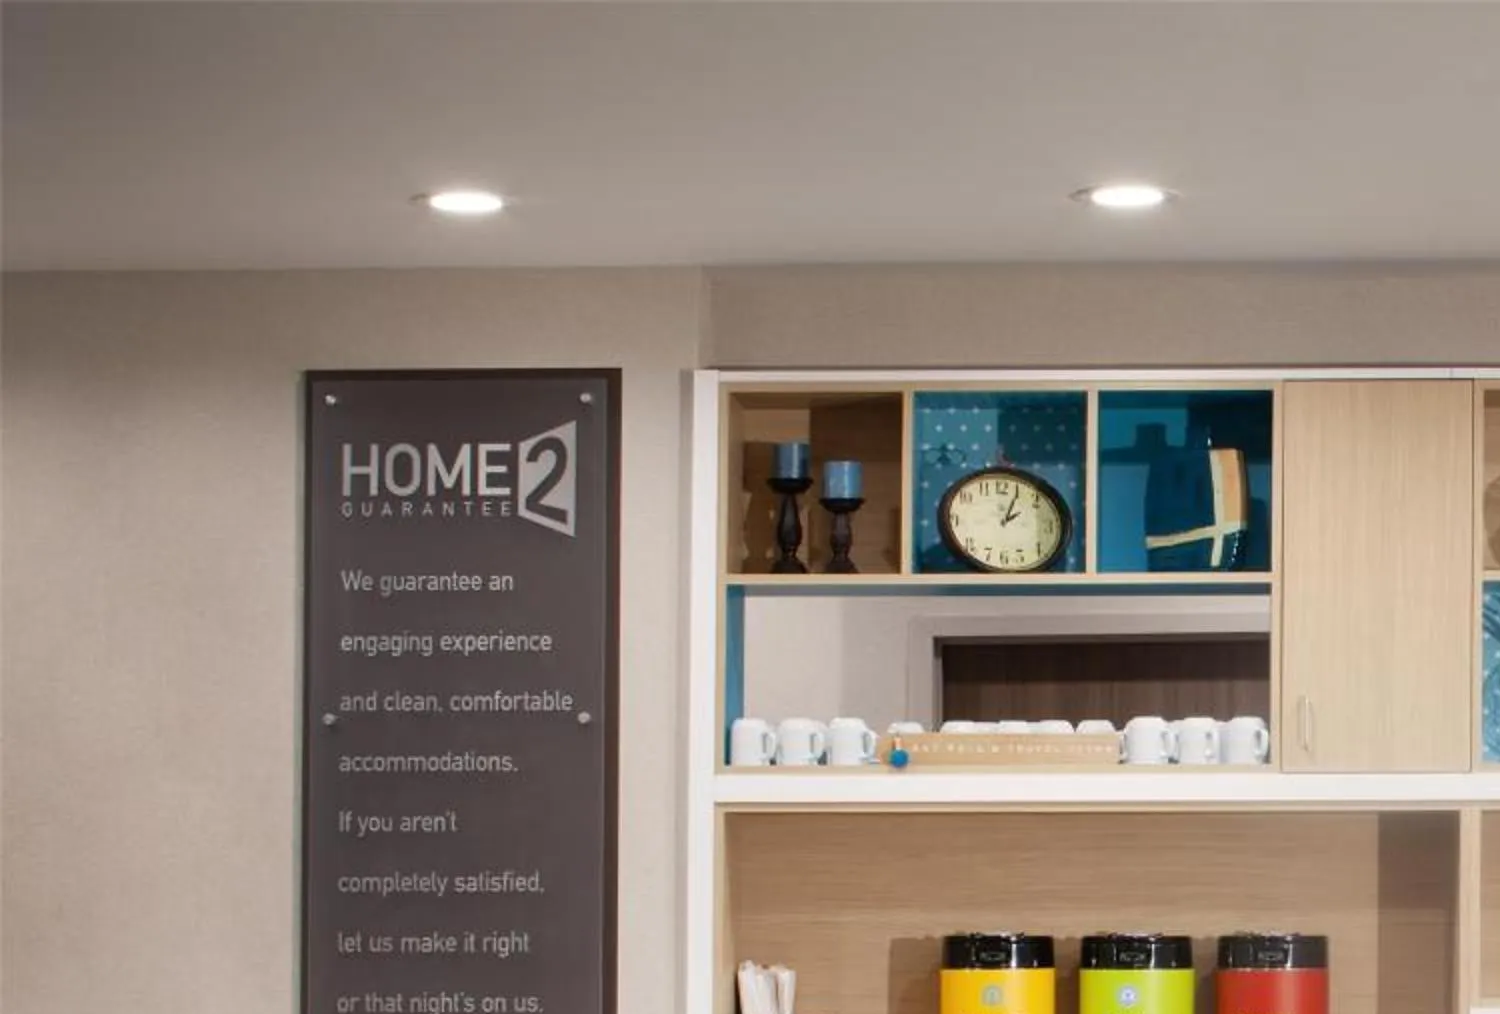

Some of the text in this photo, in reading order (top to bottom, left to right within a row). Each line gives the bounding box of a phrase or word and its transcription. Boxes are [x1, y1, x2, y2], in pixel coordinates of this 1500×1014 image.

[341, 501, 512, 518] GUARANTEE
[341, 570, 514, 597] We guarantee an
[340, 629, 553, 657] engaging experience
[339, 690, 378, 712] and
[449, 690, 574, 712] comfortable
[339, 751, 519, 773] accommodations.
[339, 811, 458, 837] If you aren't
[338, 871, 449, 897] completely
[338, 931, 530, 958] let us make it right
[337, 996, 361, 1013] or
[365, 992, 403, 1013] that
[481, 996, 508, 1013] on
[514, 996, 544, 1013] us.
